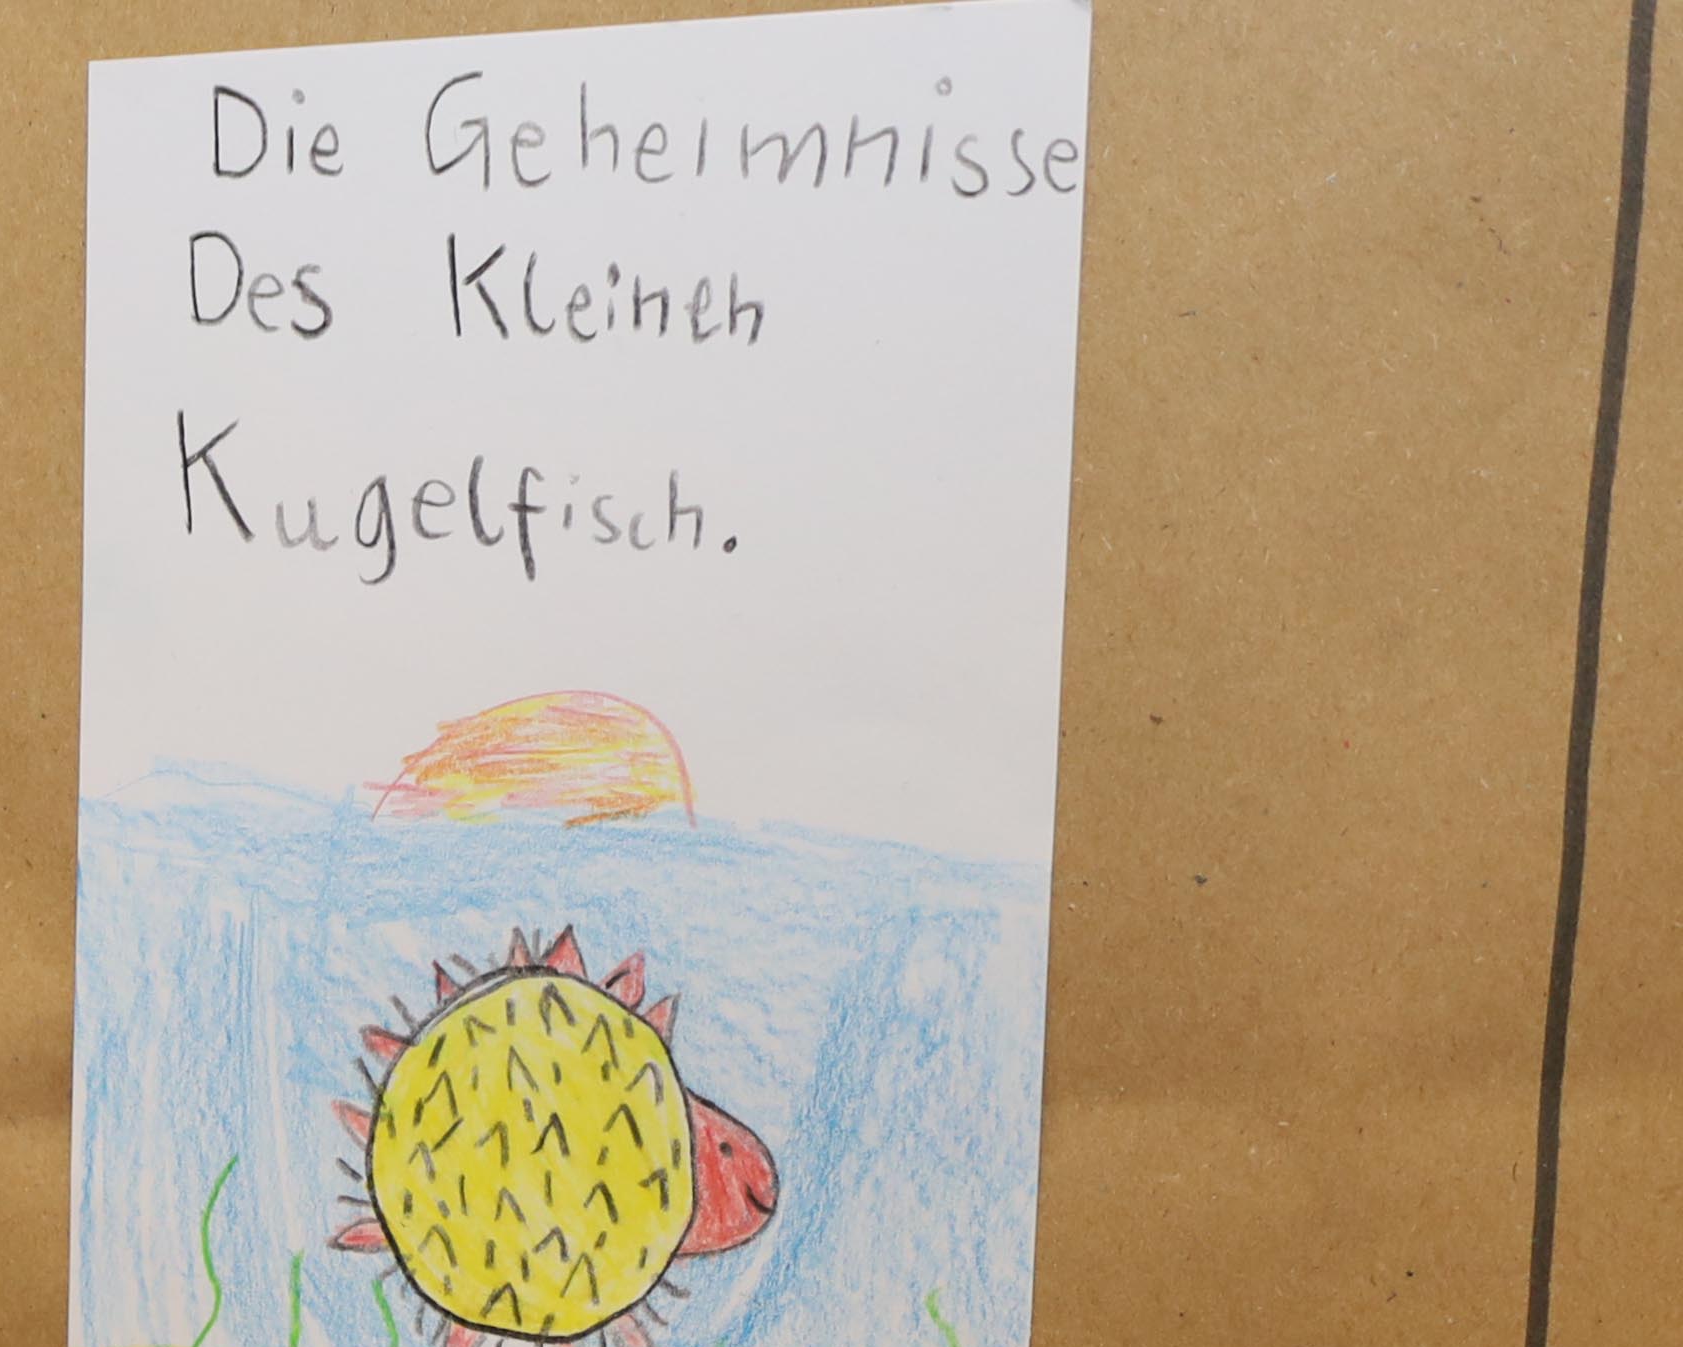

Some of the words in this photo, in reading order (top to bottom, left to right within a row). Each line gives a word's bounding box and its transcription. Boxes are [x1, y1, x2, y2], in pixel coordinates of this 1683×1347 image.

[212, 85, 345, 178] Die
[424, 70, 1082, 199] Geheimnisse
[188, 230, 334, 340] Des
[445, 233, 766, 346] Kleinen
[176, 410, 740, 586] Kugelfisch.
